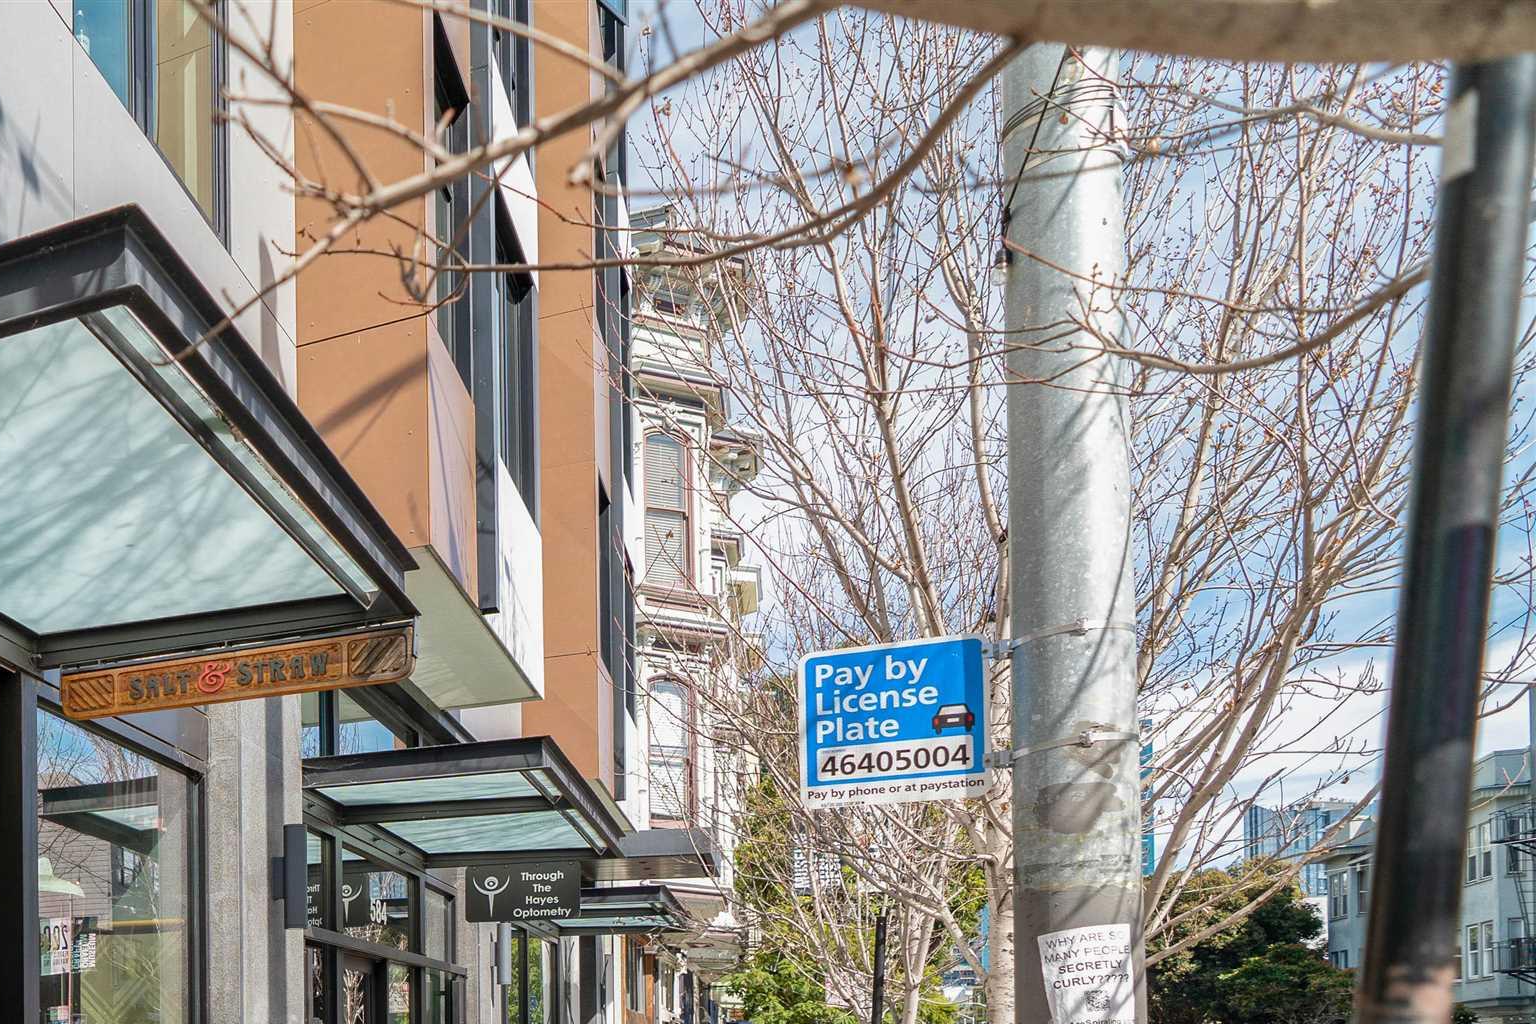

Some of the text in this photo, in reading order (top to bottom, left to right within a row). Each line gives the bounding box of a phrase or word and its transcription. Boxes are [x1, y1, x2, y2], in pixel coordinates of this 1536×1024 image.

[128, 651, 329, 702] SALT & STRAW
[815, 655, 928, 690] Pay by
[816, 685, 939, 716] License
[816, 716, 900, 744] Plate
[821, 744, 970, 776] 46405004
[808, 778, 985, 800] Pay by phone or at paystation
[520, 870, 564, 882] Through
[533, 883, 552, 893] The
[525, 895, 560, 906] Hayes
[370, 900, 387, 925] 584
[513, 907, 572, 919] Optometry
[1046, 936, 1075, 949] WHY
[1080, 932, 1104, 943] ARE
[1045, 945, 1130, 963] MANY PEOPLE
[1058, 960, 1122, 975] SECRETLY
